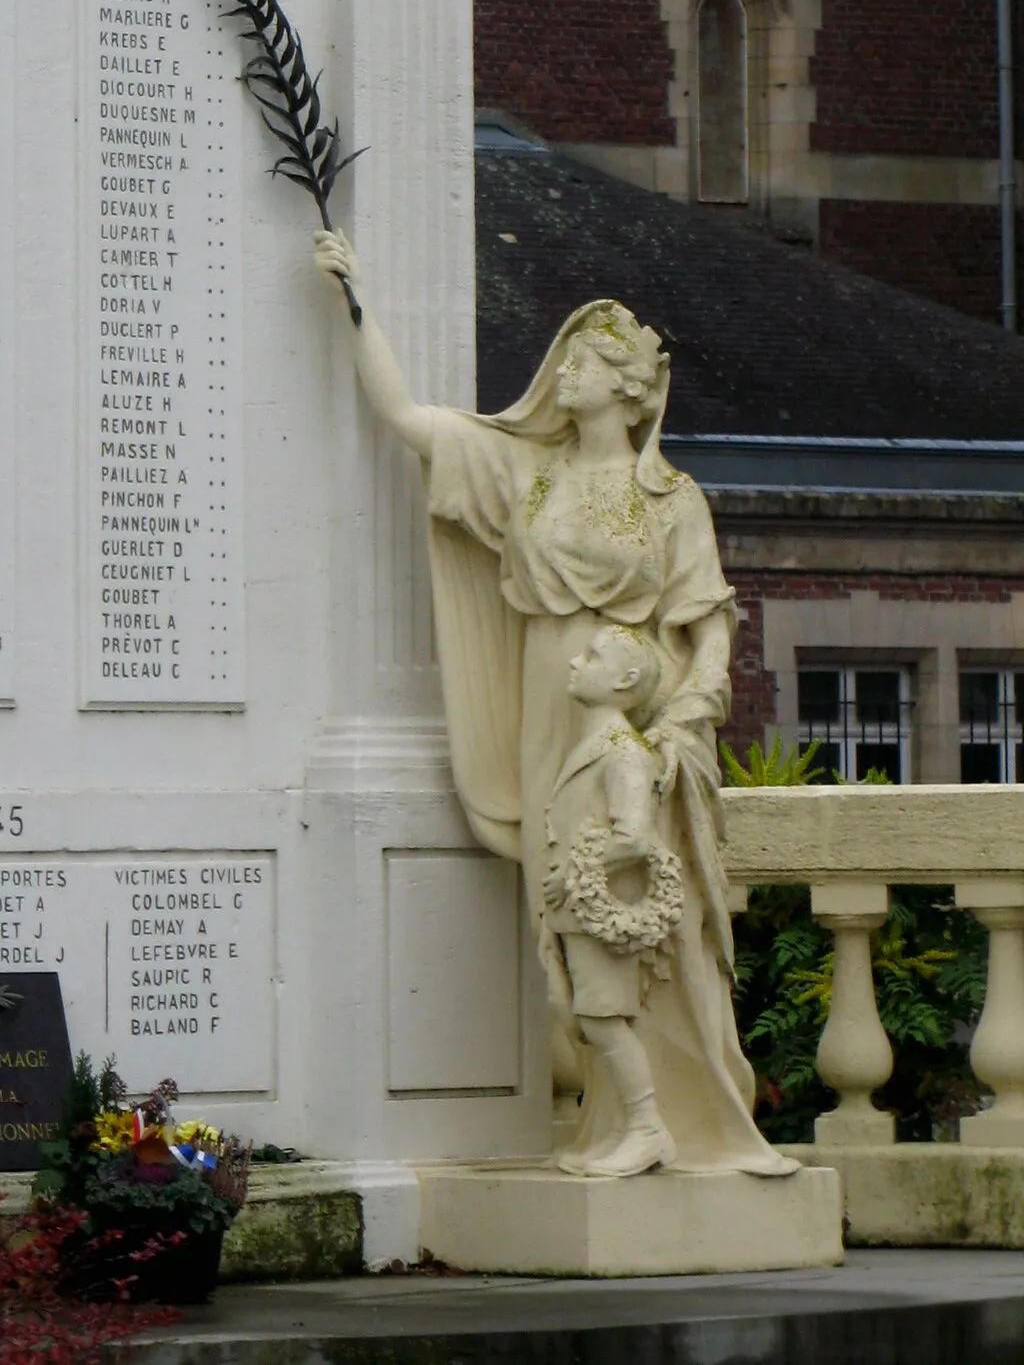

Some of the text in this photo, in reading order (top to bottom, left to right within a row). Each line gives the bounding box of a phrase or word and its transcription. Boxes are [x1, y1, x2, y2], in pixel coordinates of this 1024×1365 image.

[99, 6, 190, 31] MARLIERE G
[99, 30, 167, 52] KREBS E
[99, 102, 196, 125] DUQUESNE M
[99, 126, 188, 149] PANNEQUIN L
[100, 175, 171, 196] GOUBET G
[100, 223, 176, 244] LUPART A
[99, 296, 161, 315] DORIA V
[100, 320, 180, 340] DUCLERT P
[100, 368, 187, 389] LEMAIRE A
[100, 440, 177, 460] MASSE N
[100, 539, 184, 559] GUERLET D
[115, 868, 261, 885] VICTIMES CIVILES
[36, 896, 45, 912] A
[132, 894, 243, 910] COLOMBEL G
[34, 922, 43, 939] J
[132, 919, 206, 936] DEMAY A
[56, 946, 64, 963] J
[132, 944, 238, 961] LEFEBVRE E
[132, 969, 211, 986] SAUPIC R
[131, 993, 219, 1011] RICHARD C
[131, 1017, 220, 1035] BALAND F
[0, 1090, 18, 1103] LA
